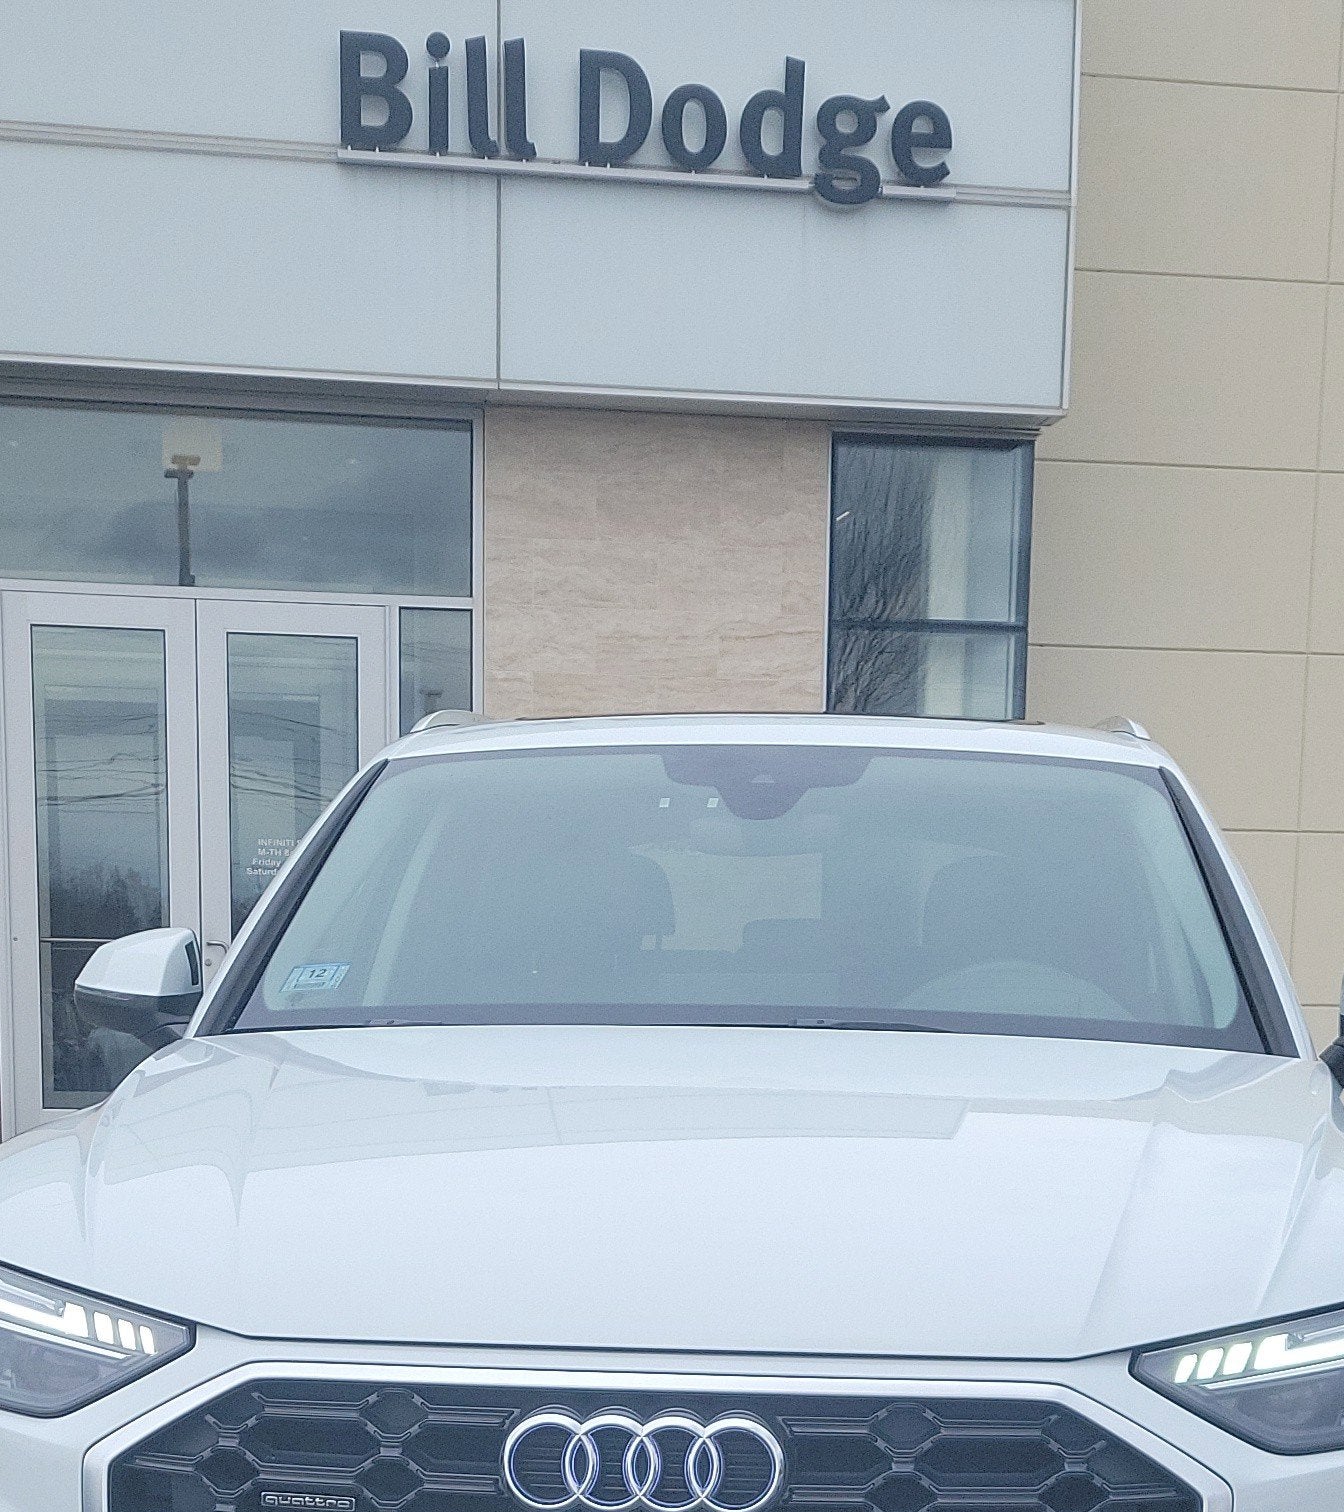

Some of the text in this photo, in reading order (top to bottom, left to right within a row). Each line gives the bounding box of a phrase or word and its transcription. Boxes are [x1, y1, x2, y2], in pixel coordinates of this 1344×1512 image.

[340, 29, 954, 205] Bill Dodge
[252, 858, 282, 867] Friday
[308, 968, 327, 978] 12
[265, 1496, 350, 1508] quattro
